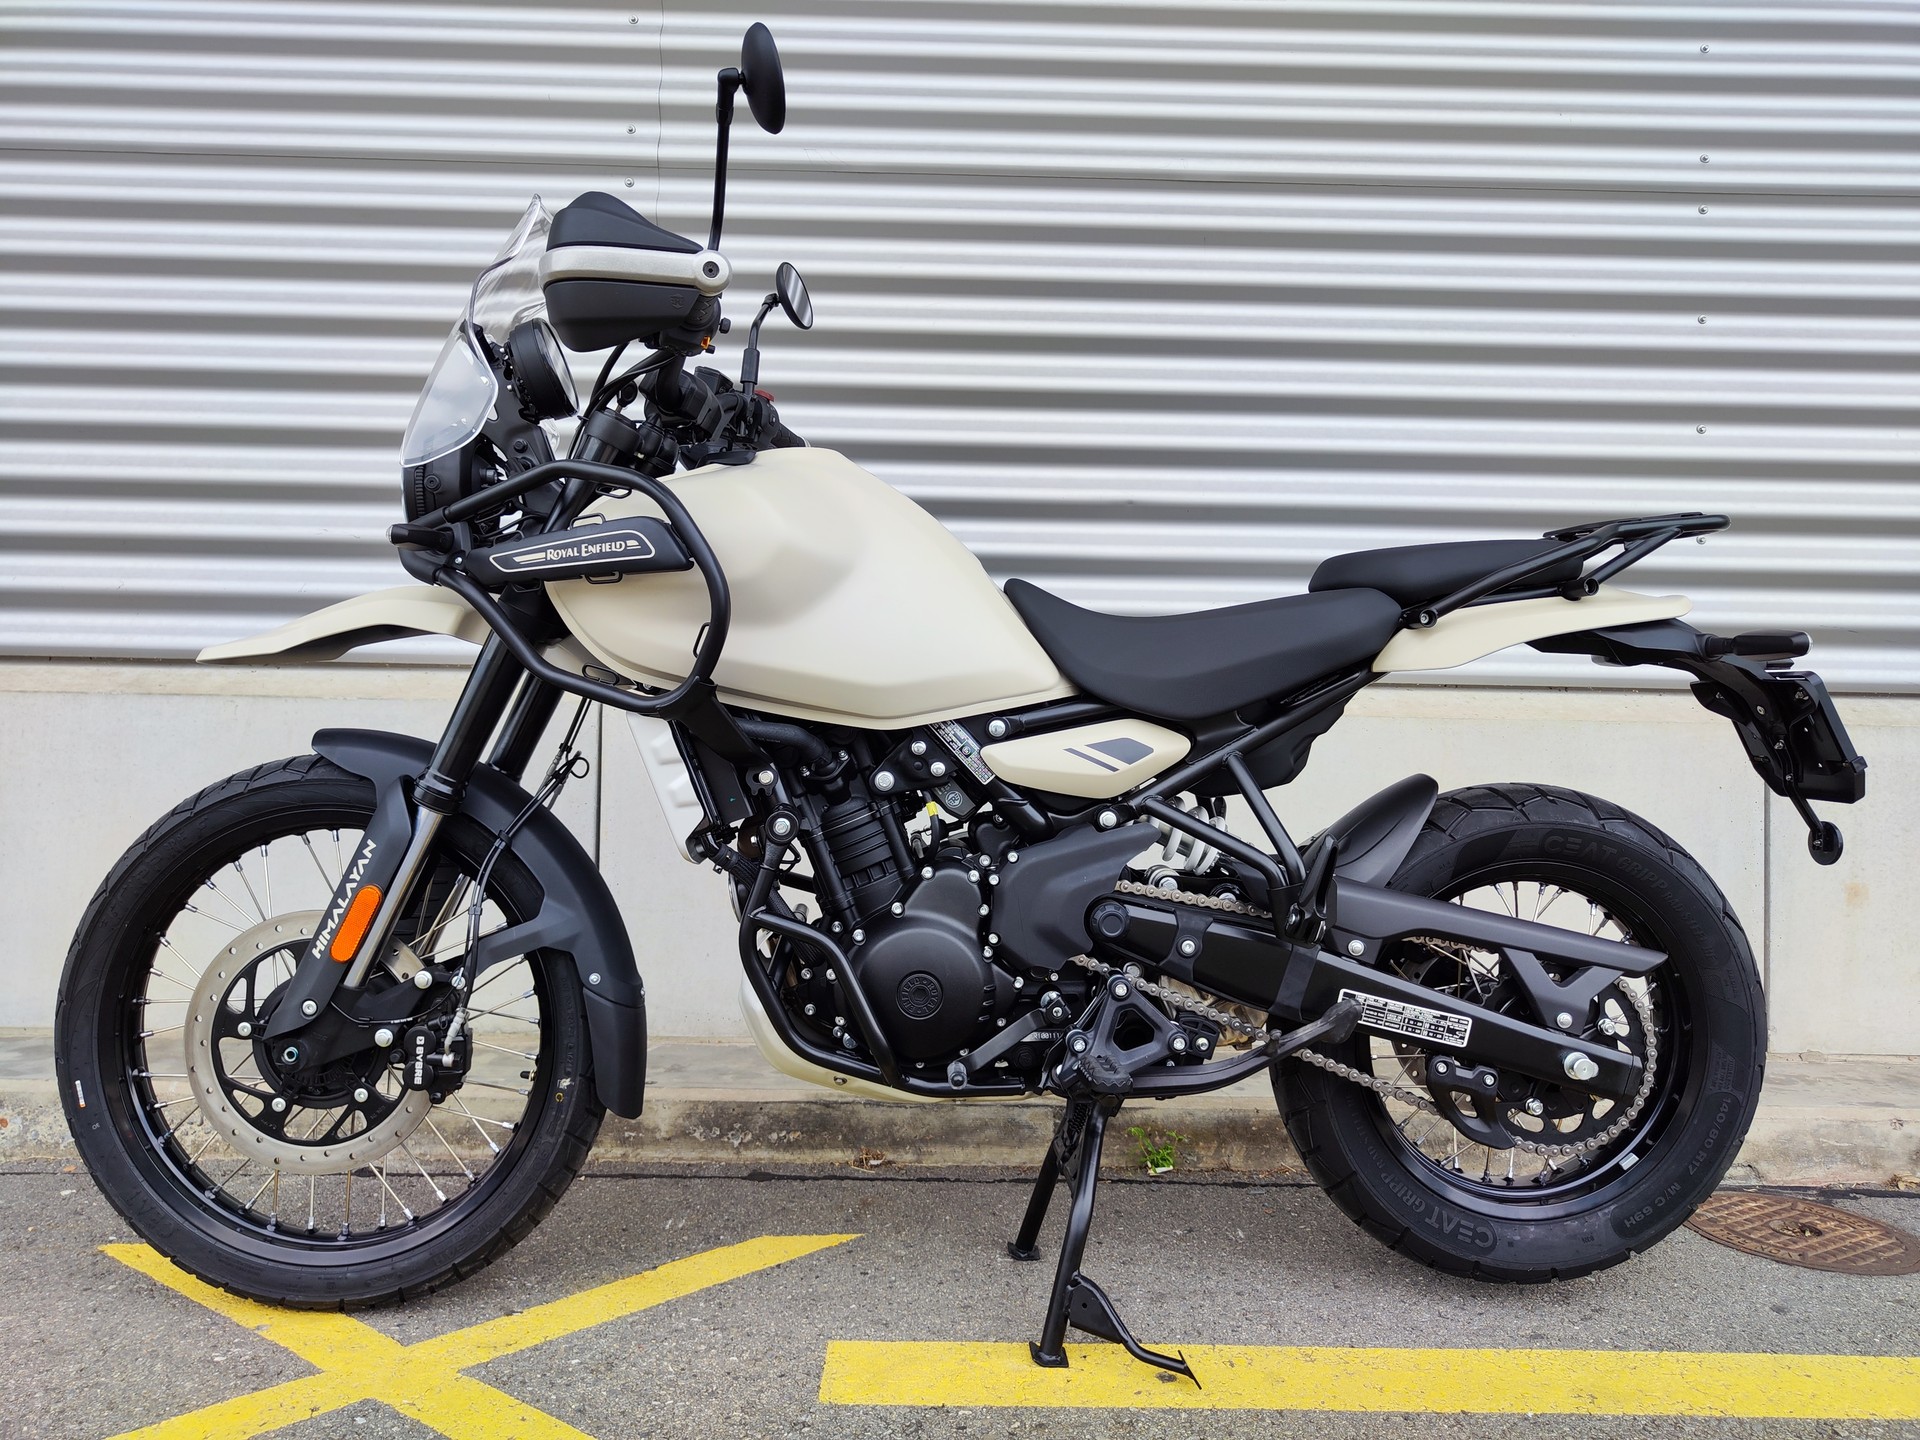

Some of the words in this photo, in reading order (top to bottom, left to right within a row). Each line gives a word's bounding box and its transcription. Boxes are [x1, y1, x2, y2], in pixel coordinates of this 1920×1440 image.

[546, 547, 580, 561] ROYAL
[581, 541, 625, 557] ENFIELD
[1544, 834, 1618, 864] CEAT
[1617, 856, 1669, 889] GRIPP
[312, 838, 376, 960] HIMALAYAN
[901, 977, 921, 1013] ENFIELD
[922, 982, 938, 1013] ROYAL
[413, 1046, 424, 1085] BYBRE
[1705, 1096, 1733, 1152] 140/80
[1687, 1150, 1708, 1176] R17
[1380, 1171, 1426, 1213] GRIPP
[1654, 1181, 1682, 1207] M/C
[1424, 1205, 1495, 1248] CEAT
[1623, 1205, 1653, 1229] 69H
